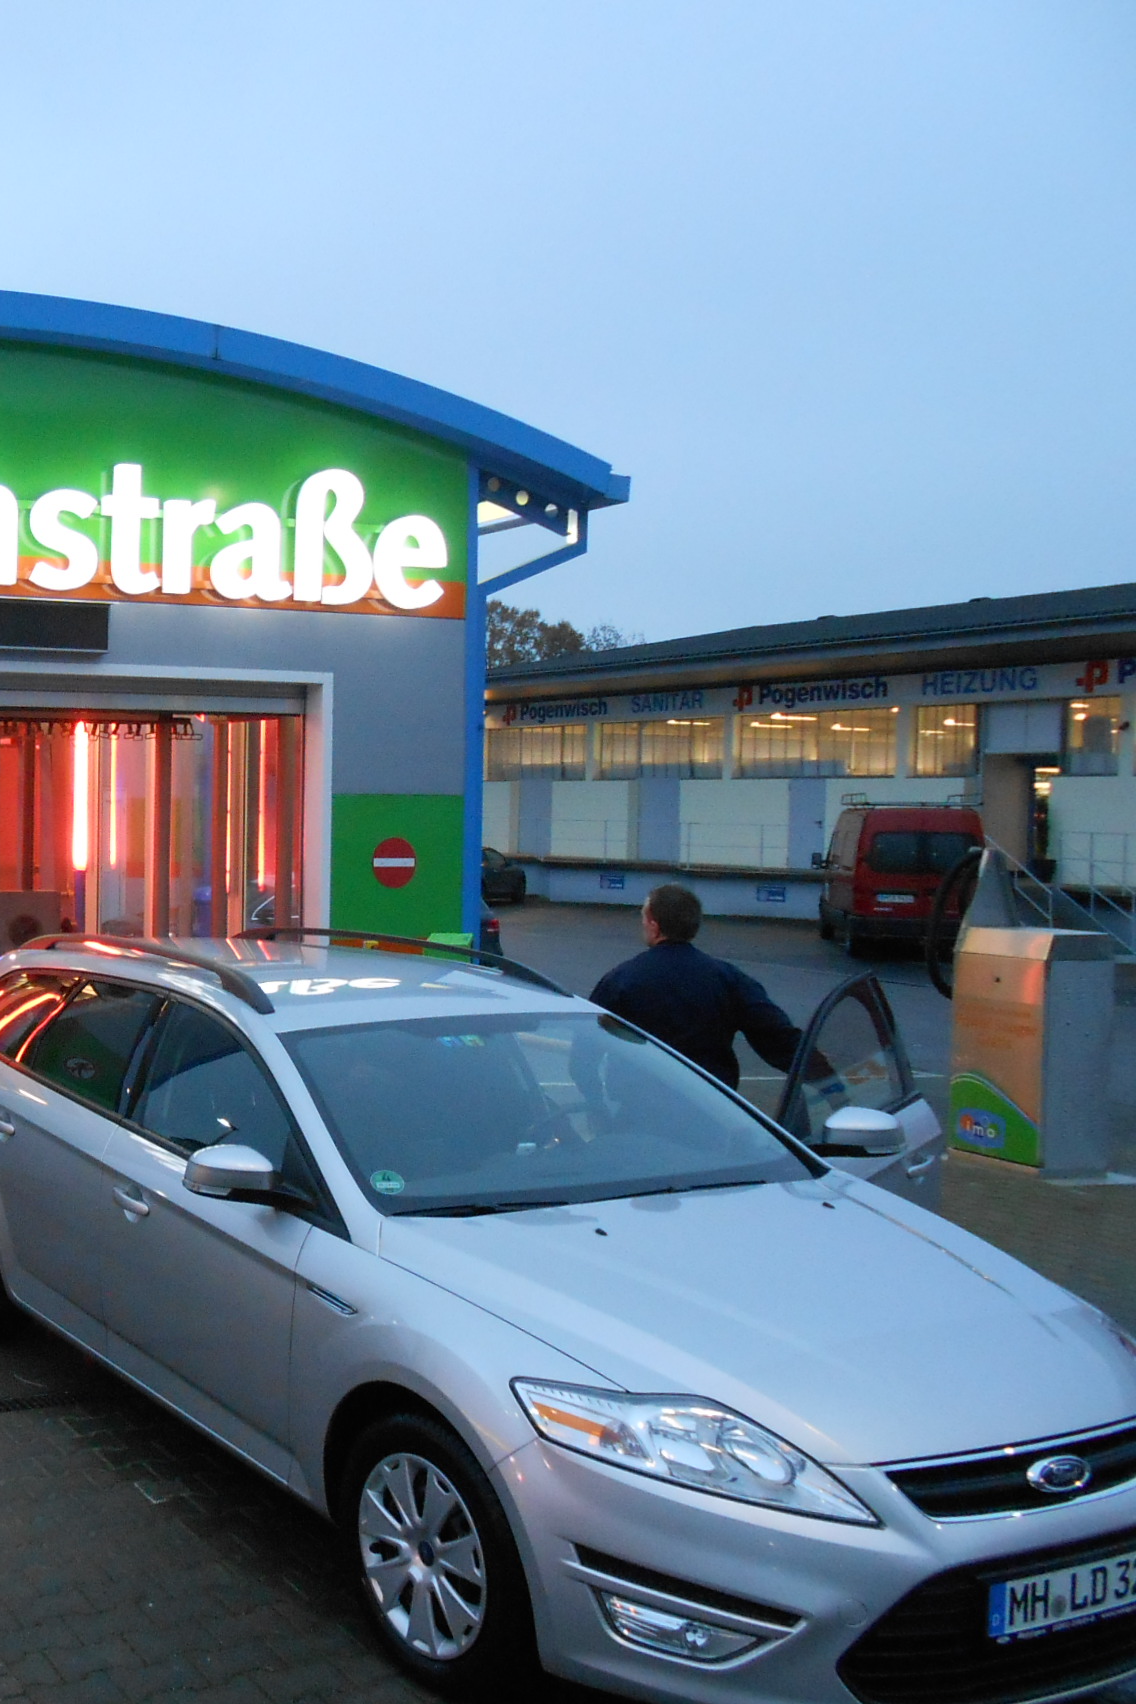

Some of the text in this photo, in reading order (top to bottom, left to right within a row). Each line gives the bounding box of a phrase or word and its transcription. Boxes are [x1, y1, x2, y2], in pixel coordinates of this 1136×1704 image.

[759, 676, 889, 709] Pogenwisch
[922, 668, 1038, 696] HEIZUNG
[520, 699, 607, 723] Pogenwisch
[1008, 1578, 1051, 1627] MH
[1070, 1565, 1108, 1612] LD
